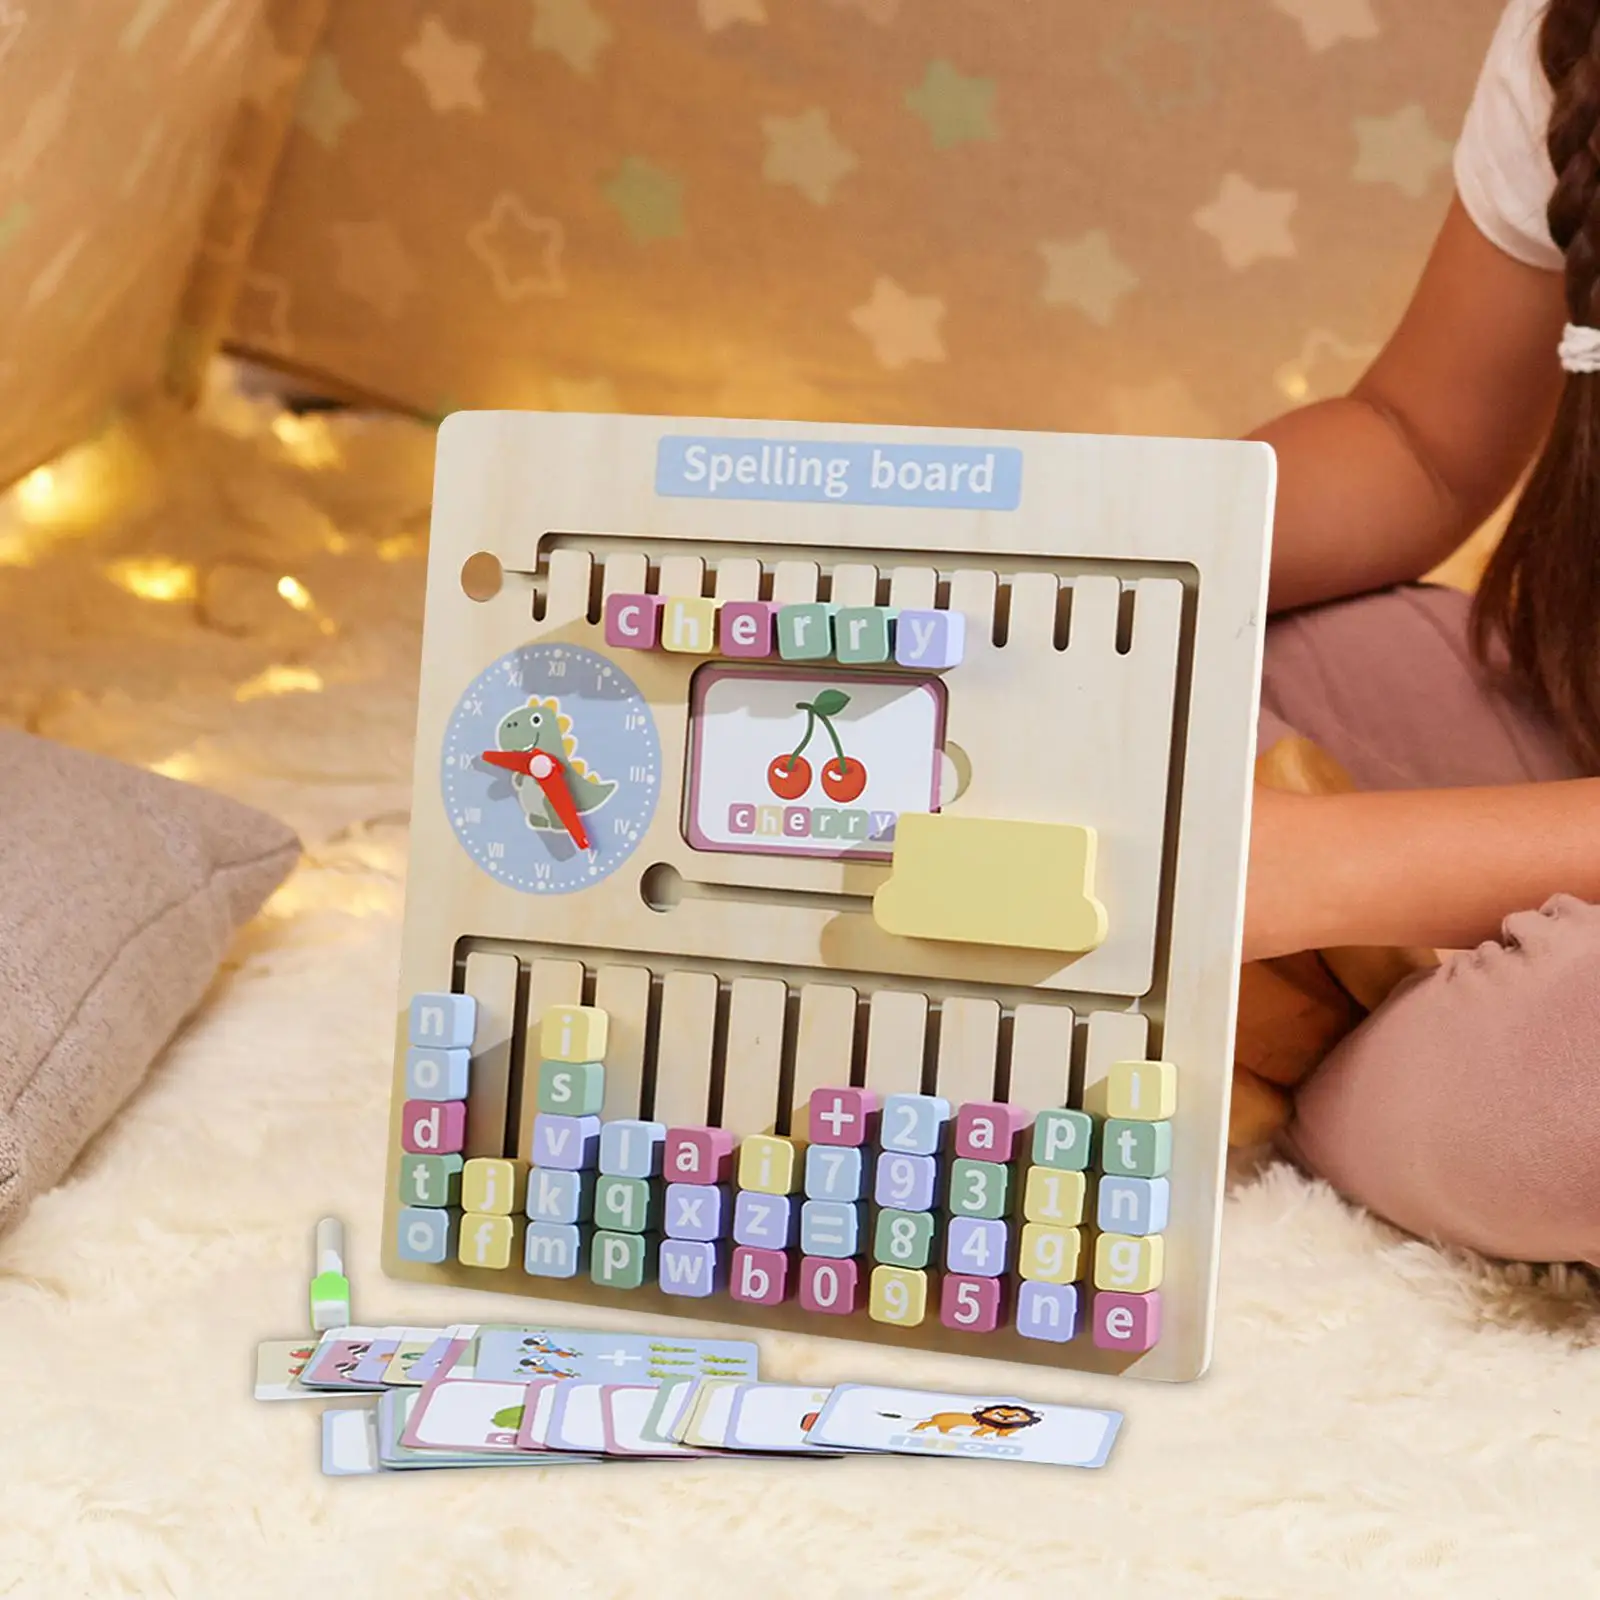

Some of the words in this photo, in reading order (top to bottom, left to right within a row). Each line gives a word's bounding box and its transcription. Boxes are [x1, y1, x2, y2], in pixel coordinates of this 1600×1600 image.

[683, 444, 850, 498] Spelling
[869, 449, 995, 493] board
[507, 671, 523, 687] XI
[471, 700, 483, 716] X
[630, 765, 647, 784] III
[614, 818, 631, 835] IV
[735, 809, 894, 838] cherry
[534, 862, 551, 880] VI
[419, 1005, 444, 1036] n
[560, 1014, 573, 1057] i
[550, 1072, 573, 1104] s
[413, 1107, 440, 1149] d
[544, 1127, 571, 1157] v
[892, 1105, 919, 1147] 2
[967, 1117, 994, 1150] a
[1044, 1116, 1075, 1162] p
[675, 1141, 700, 1172] a
[758, 1145, 772, 1187] i
[1117, 1129, 1138, 1170] t
[412, 1163, 431, 1201] t
[479, 1168, 497, 1211] j
[819, 1152, 845, 1194] 7
[961, 1169, 988, 1211] 3
[538, 1175, 562, 1216] k
[605, 1182, 634, 1227] q
[675, 1197, 703, 1229] x
[1038, 1176, 1063, 1219] 1
[1110, 1189, 1138, 1223] n
[745, 1205, 771, 1236] z
[889, 1216, 918, 1259] 8
[473, 1222, 492, 1263] f
[530, 1234, 567, 1265] m
[603, 1237, 630, 1281] p
[960, 1225, 990, 1268] 4
[1035, 1232, 1066, 1278] g
[1108, 1239, 1141, 1285] g
[665, 1254, 704, 1285] w
[740, 1254, 770, 1298] b
[953, 1282, 981, 1325] 5
[1031, 1294, 1060, 1328] n
[1105, 1305, 1134, 1340] e
